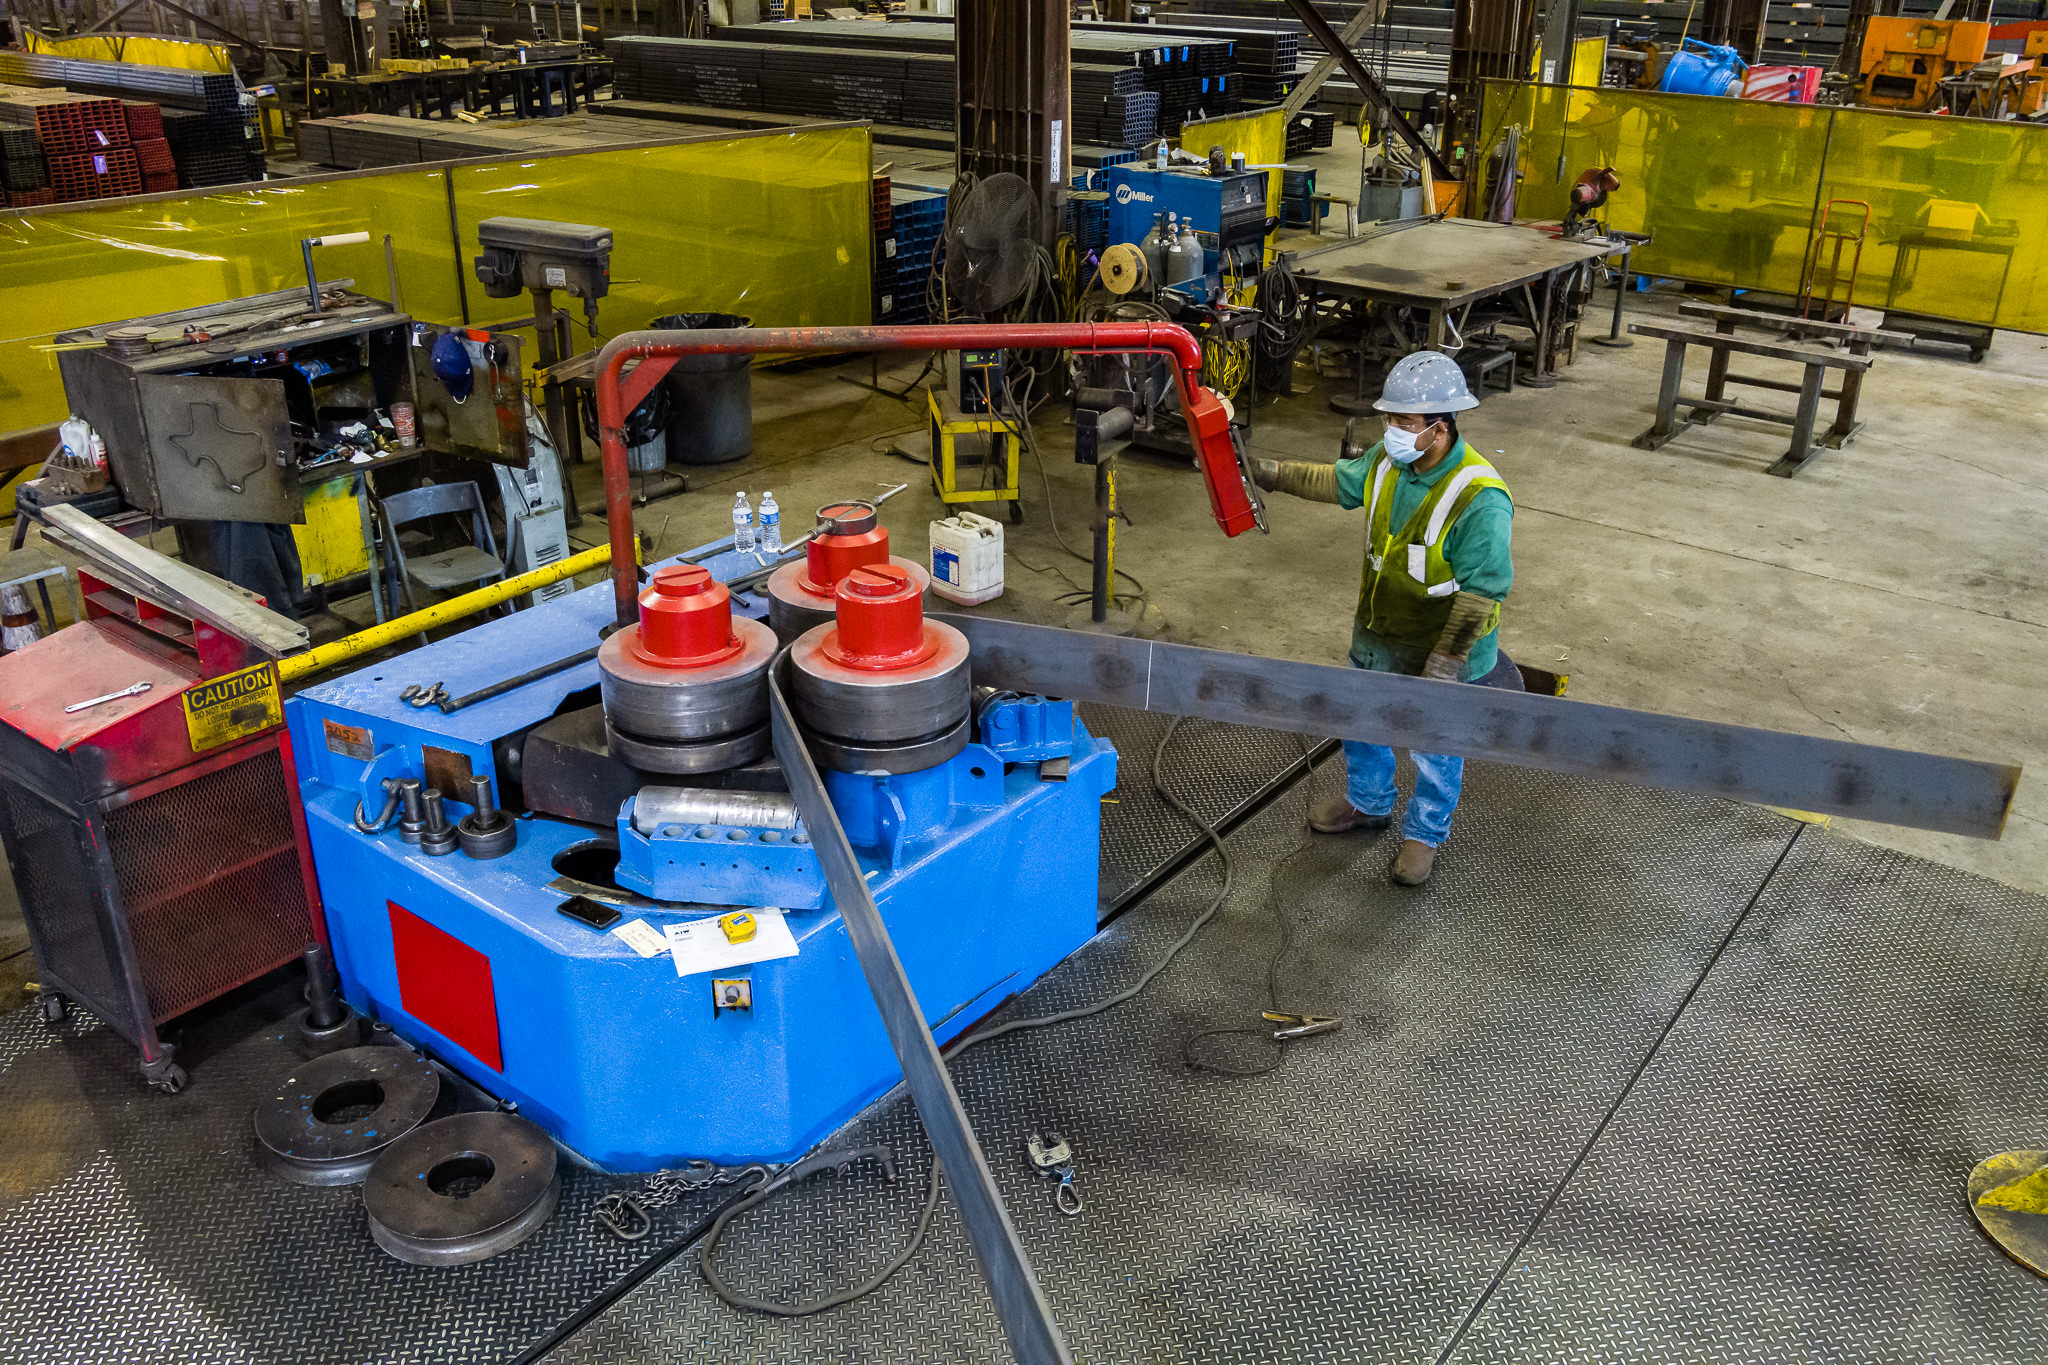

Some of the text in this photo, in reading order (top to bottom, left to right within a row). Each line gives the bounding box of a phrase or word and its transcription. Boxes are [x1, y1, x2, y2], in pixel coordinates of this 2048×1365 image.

[1131, 191, 1154, 202] Miller
[191, 669, 270, 708] CAUTION
[194, 711, 205, 720] DO
[206, 705, 220, 716] NOT
[220, 699, 240, 710] WEAR
